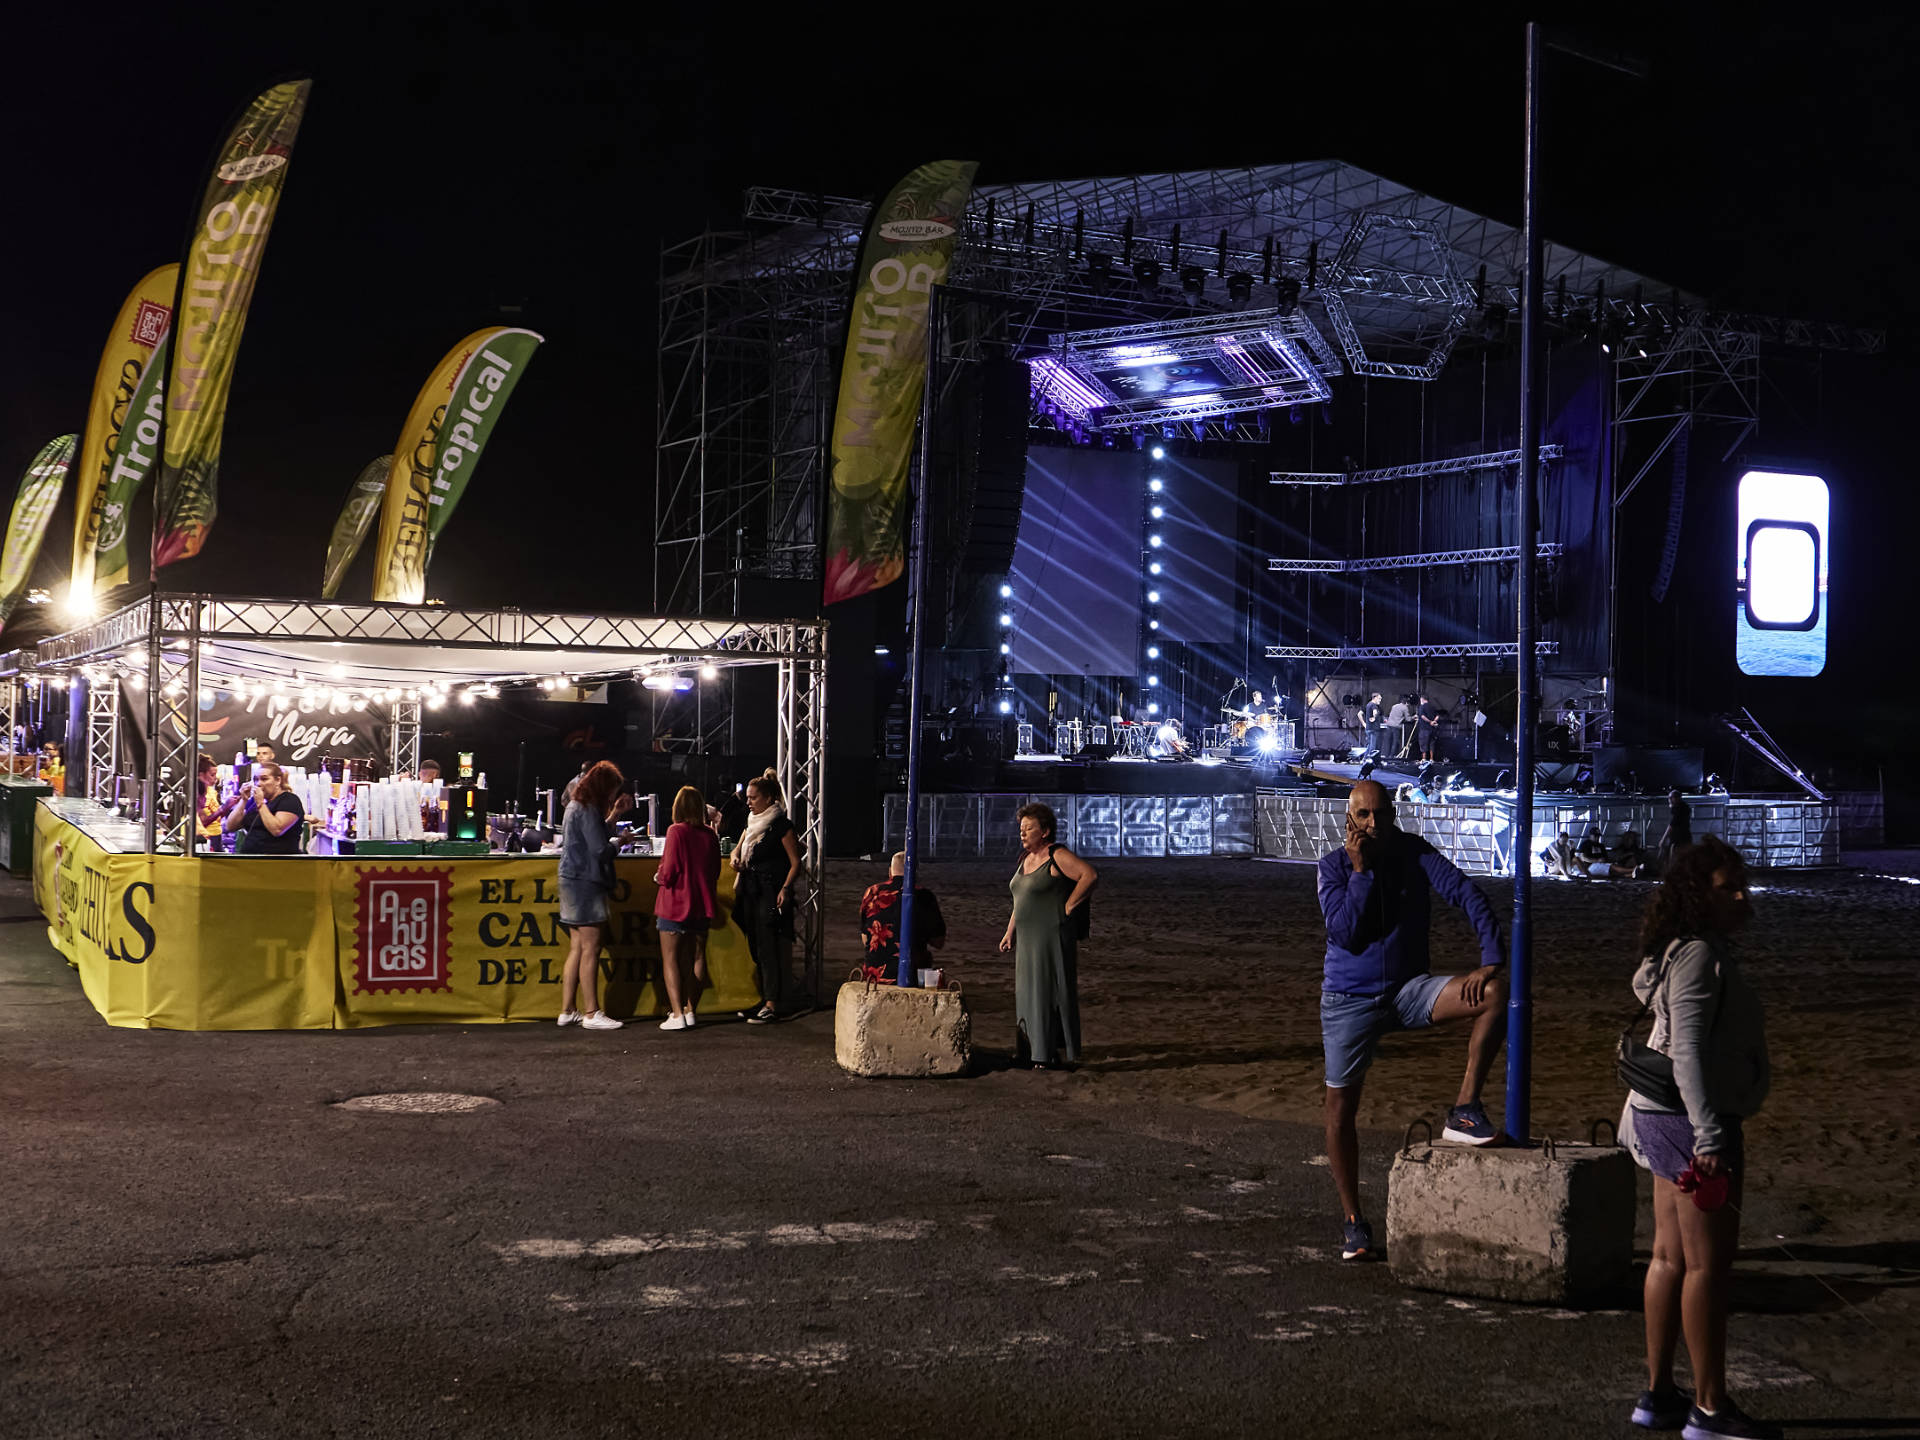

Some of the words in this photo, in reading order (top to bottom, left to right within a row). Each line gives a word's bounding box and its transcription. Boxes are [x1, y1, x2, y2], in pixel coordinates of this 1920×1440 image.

[889, 225, 923, 235] MOJITO
[924, 225, 945, 235] BAR
[171, 200, 241, 414] MOJITO
[841, 258, 908, 448] MOJITO
[109, 376, 165, 487] Trop
[268, 709, 356, 761] Negra
[480, 879, 523, 904] EL
[535, 878, 632, 905] LO
[478, 959, 528, 986] DE
